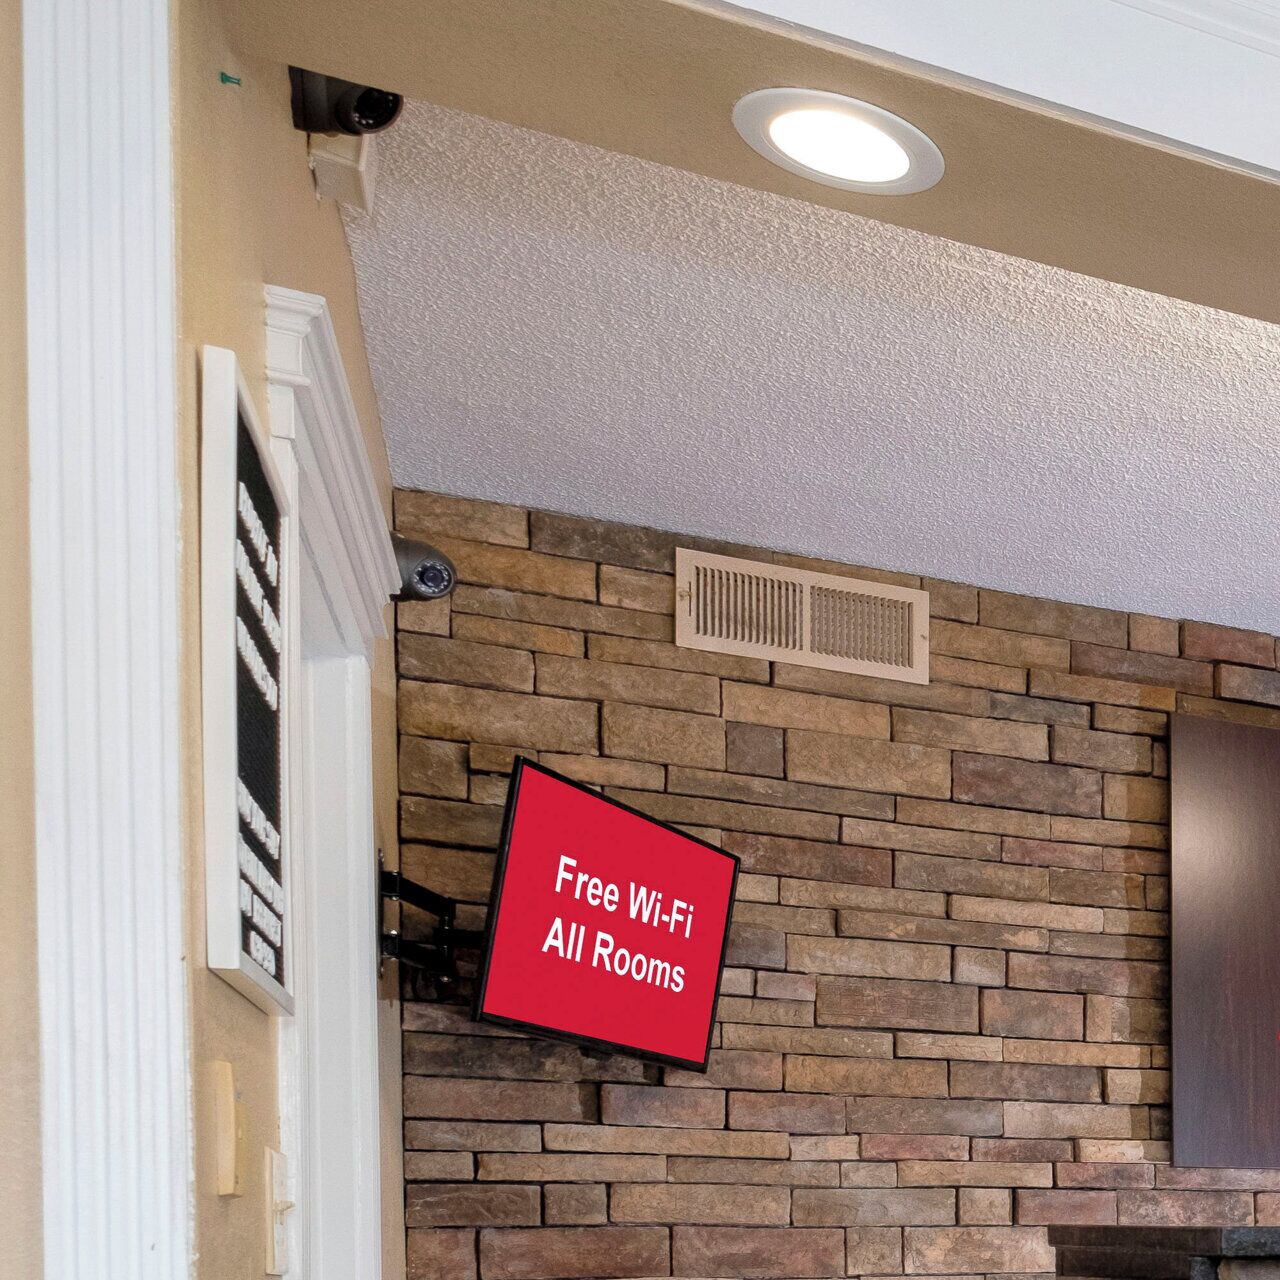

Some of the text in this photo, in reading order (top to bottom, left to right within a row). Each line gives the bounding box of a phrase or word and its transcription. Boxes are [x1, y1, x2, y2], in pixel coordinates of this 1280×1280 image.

[555, 854, 695, 939] Free Wi-Fi
[541, 916, 687, 993] All Rooms
